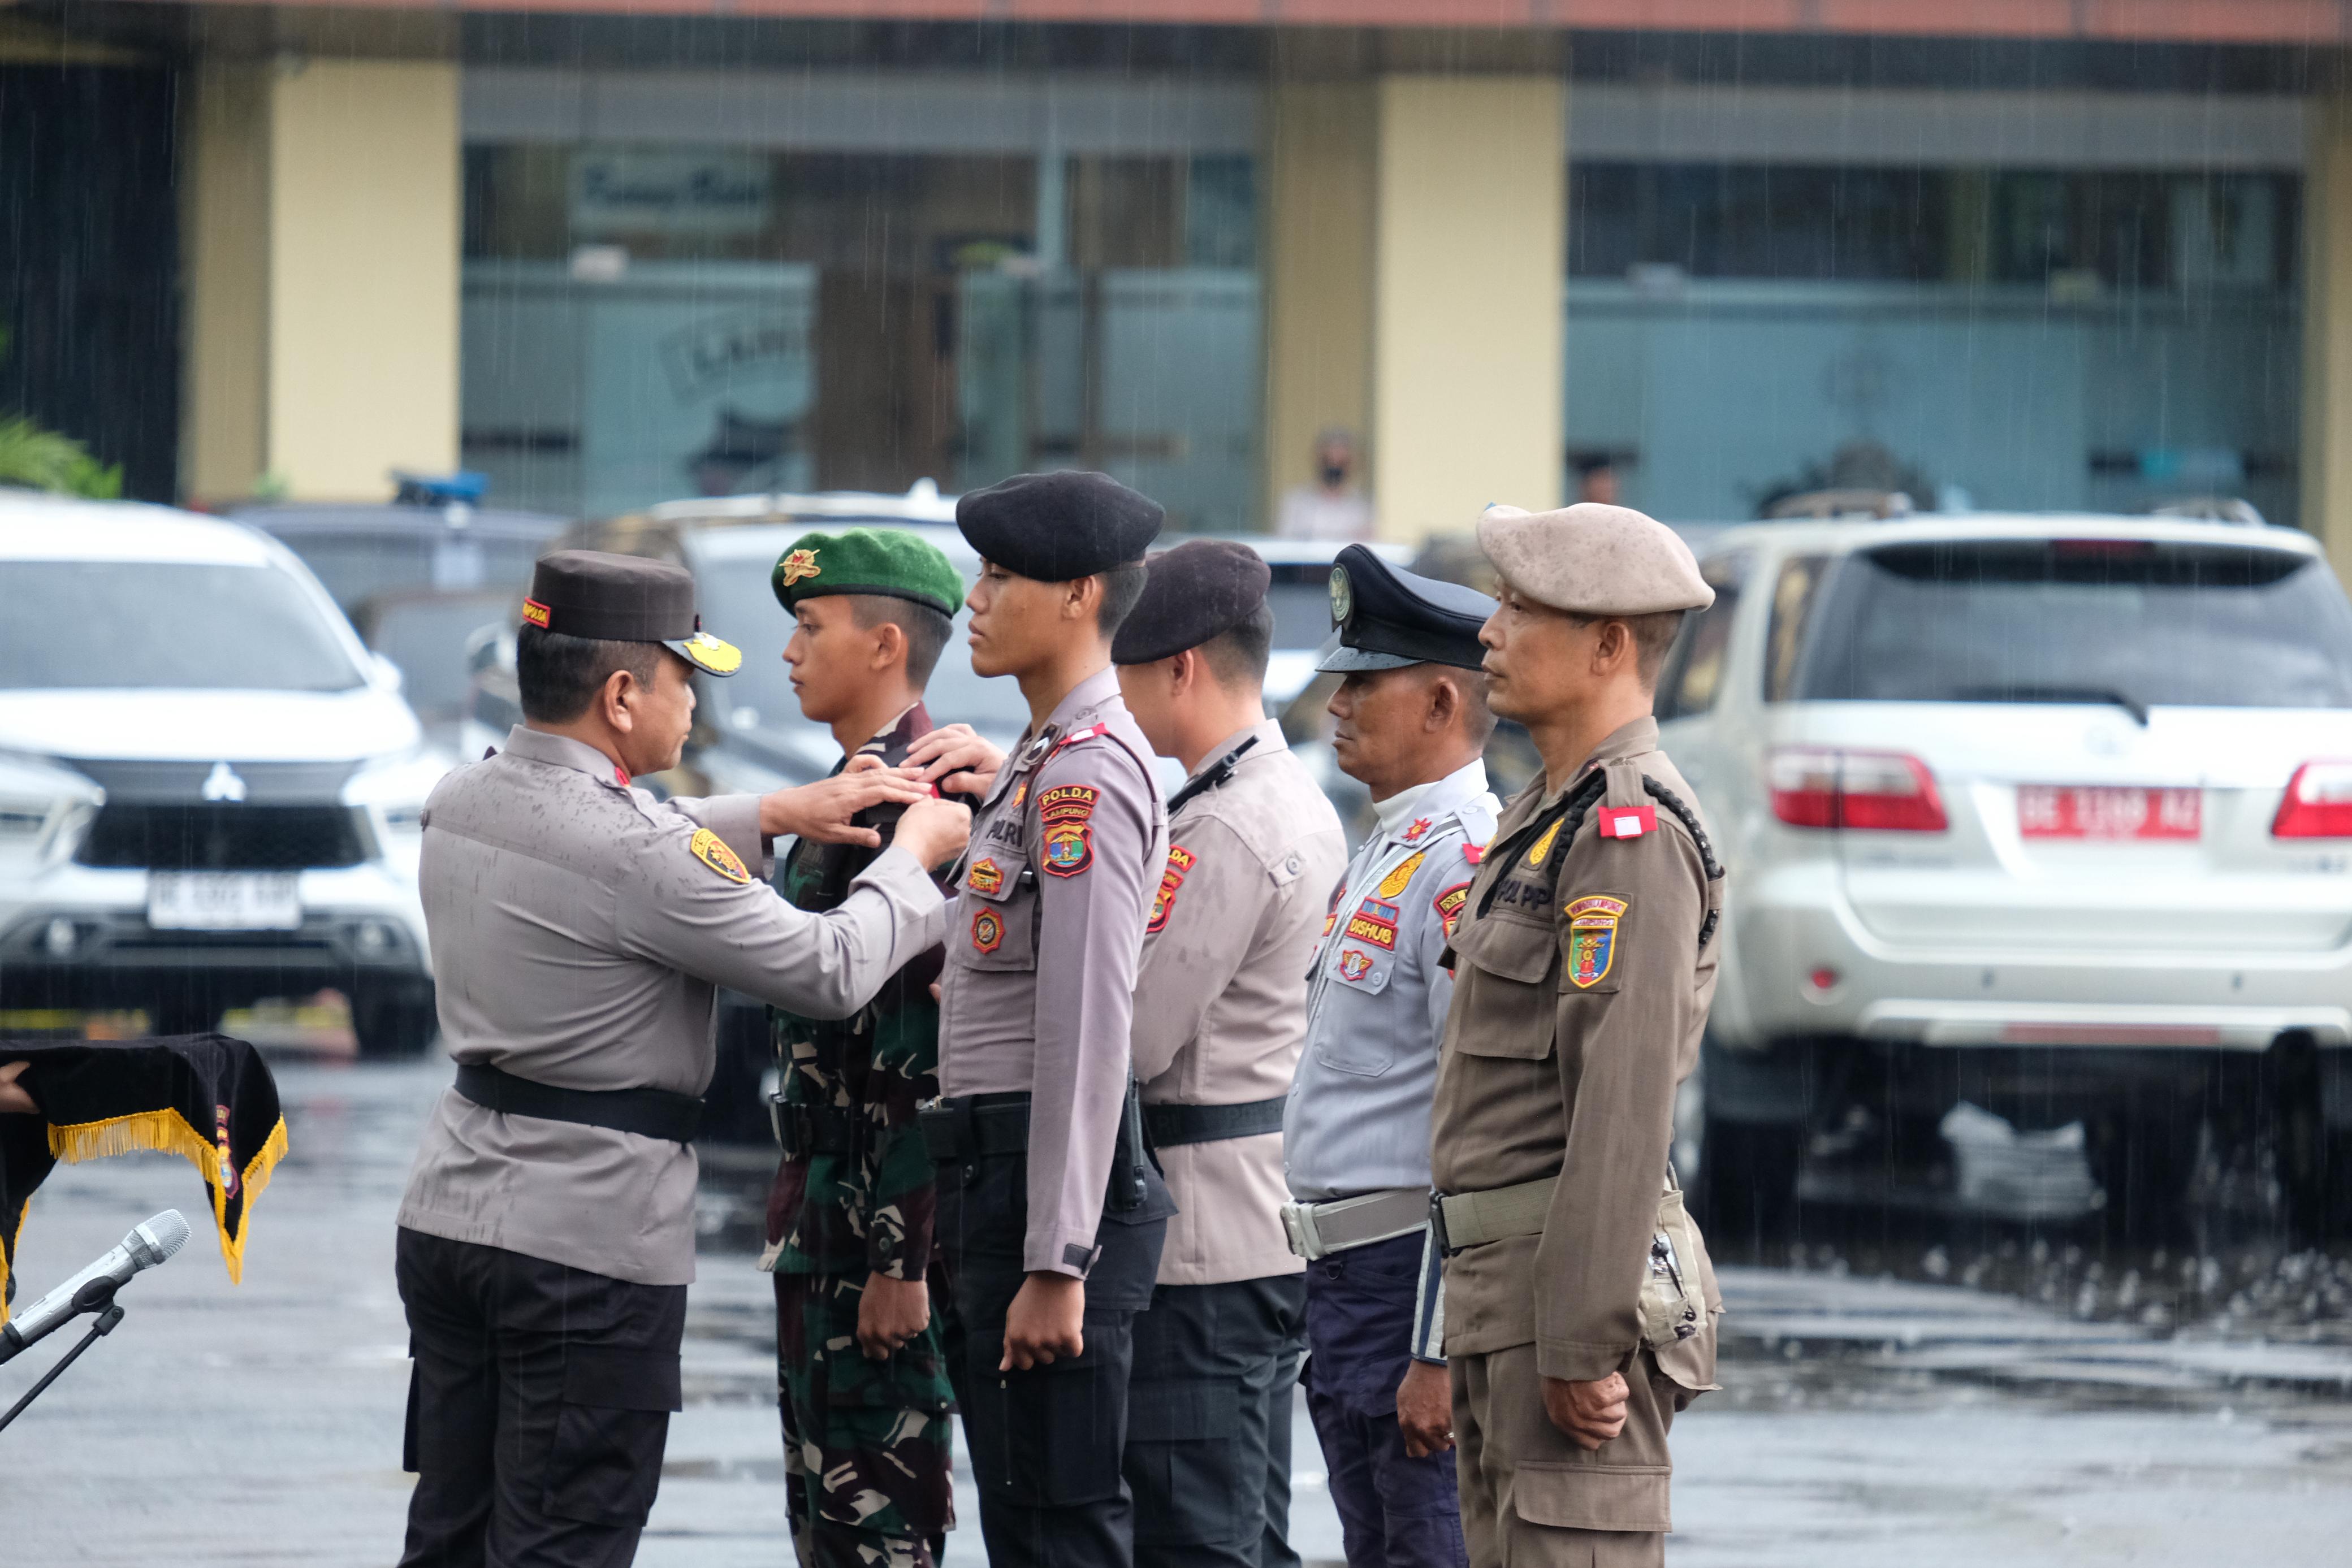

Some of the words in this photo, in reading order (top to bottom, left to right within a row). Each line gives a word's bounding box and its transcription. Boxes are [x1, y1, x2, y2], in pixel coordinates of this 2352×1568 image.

[1041, 787, 1092, 806] POLDA
[1045, 807, 1089, 819] LAMPUNG
[1349, 918, 1393, 944] DISHUB
